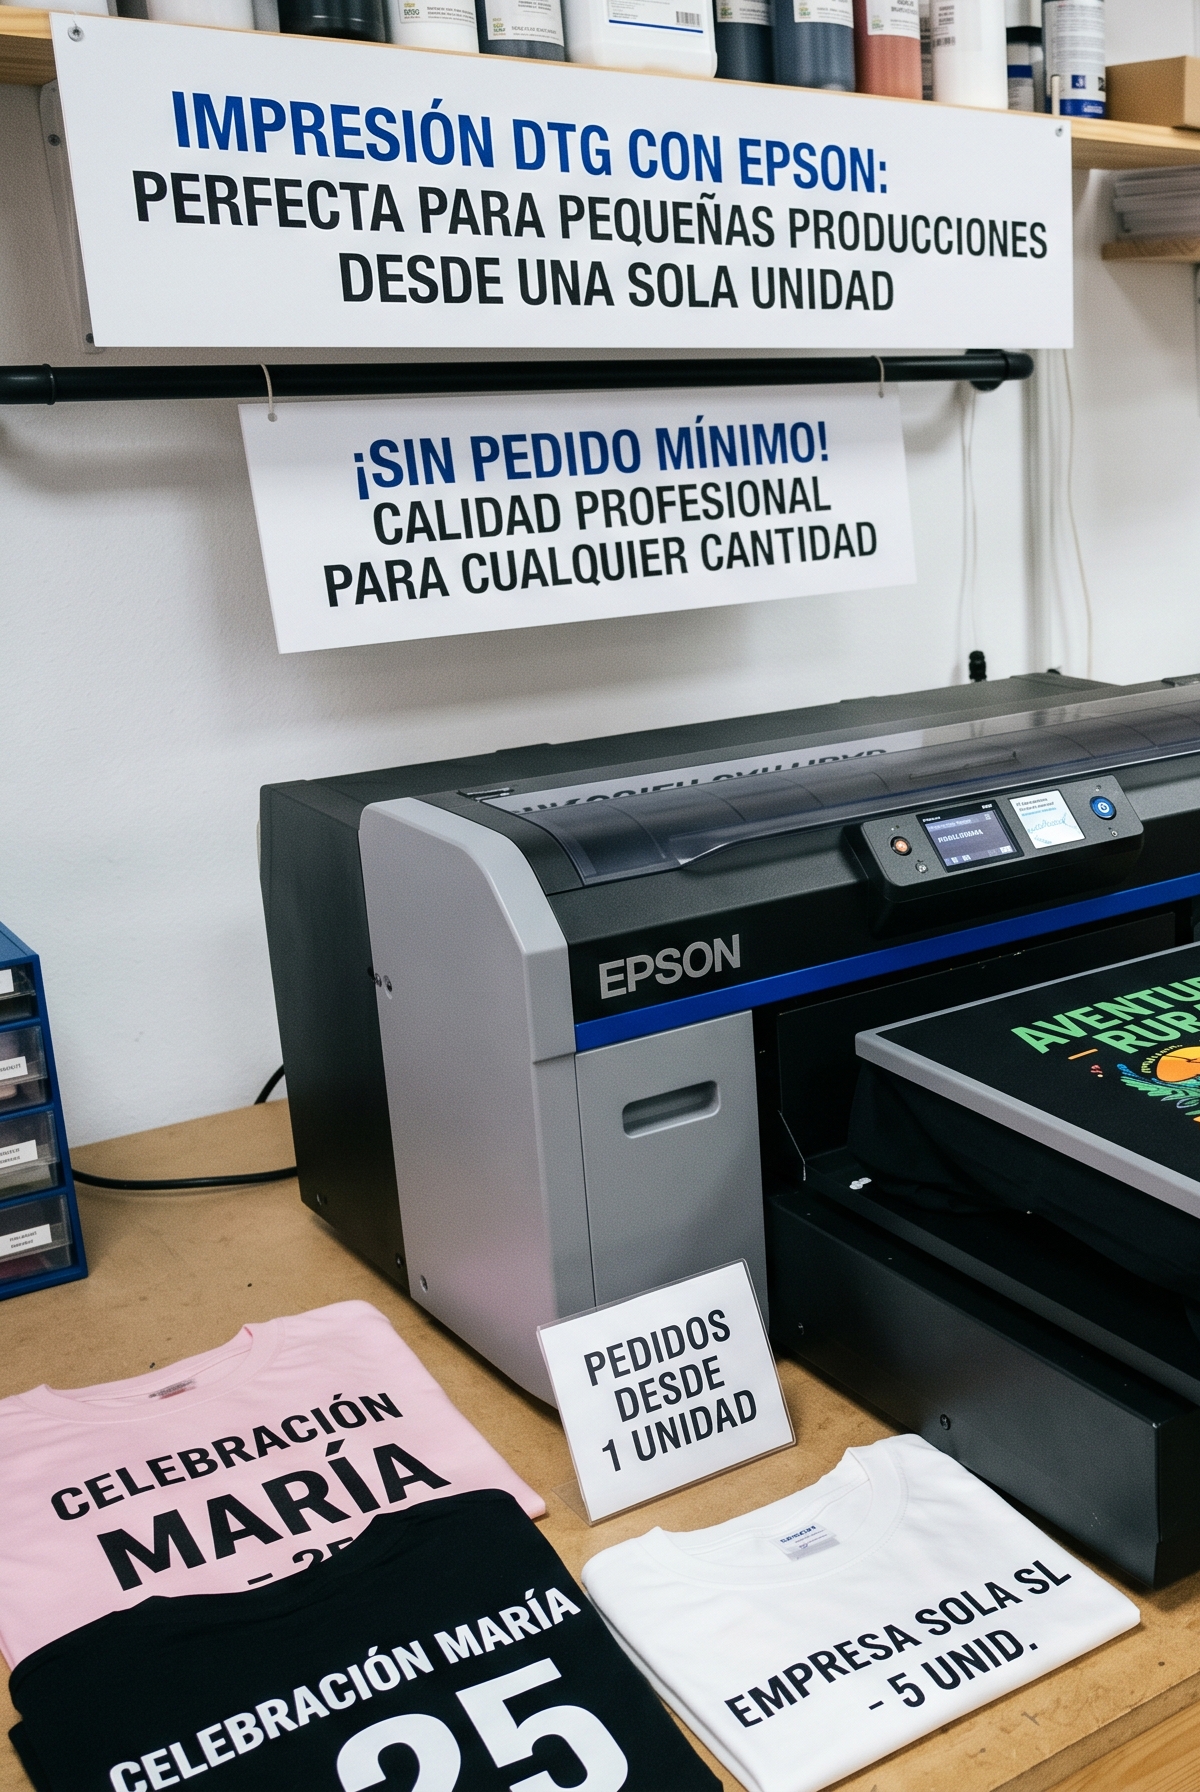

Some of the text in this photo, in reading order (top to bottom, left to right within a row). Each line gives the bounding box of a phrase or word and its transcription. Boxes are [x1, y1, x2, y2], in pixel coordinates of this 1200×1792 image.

[172, 91, 887, 194] IMPRESIÓN DTG CON EPSON:
[133, 170, 1047, 259] PERFECTA PARA PEQUEÑAS PRODUCCIONES
[339, 252, 894, 311] DESDE UNA SOLA UNIDAD
[353, 415, 829, 500] ¡SIN PEDIDO MÍNIMO!
[373, 476, 831, 545] CALIDAD PROFESIONAL
[323, 522, 877, 607] PARA CUALQUIER CANTIDAD
[599, 934, 741, 999] EPSON
[584, 1309, 730, 1386] PEDIDOS
[614, 1355, 725, 1422] DESDE
[50, 1392, 403, 1520] CELEBRACIÓN
[602, 1389, 757, 1471] 1 UNIDAD
[97, 1437, 451, 1592] MARÍA
[724, 1560, 1071, 1728] EMPRESA SOLA SL
[887, 1672, 926, 1708] 5
[921, 1627, 1038, 1691] UNID.
[109, 1587, 582, 1792] CELEBRACIÓN MARÍA
